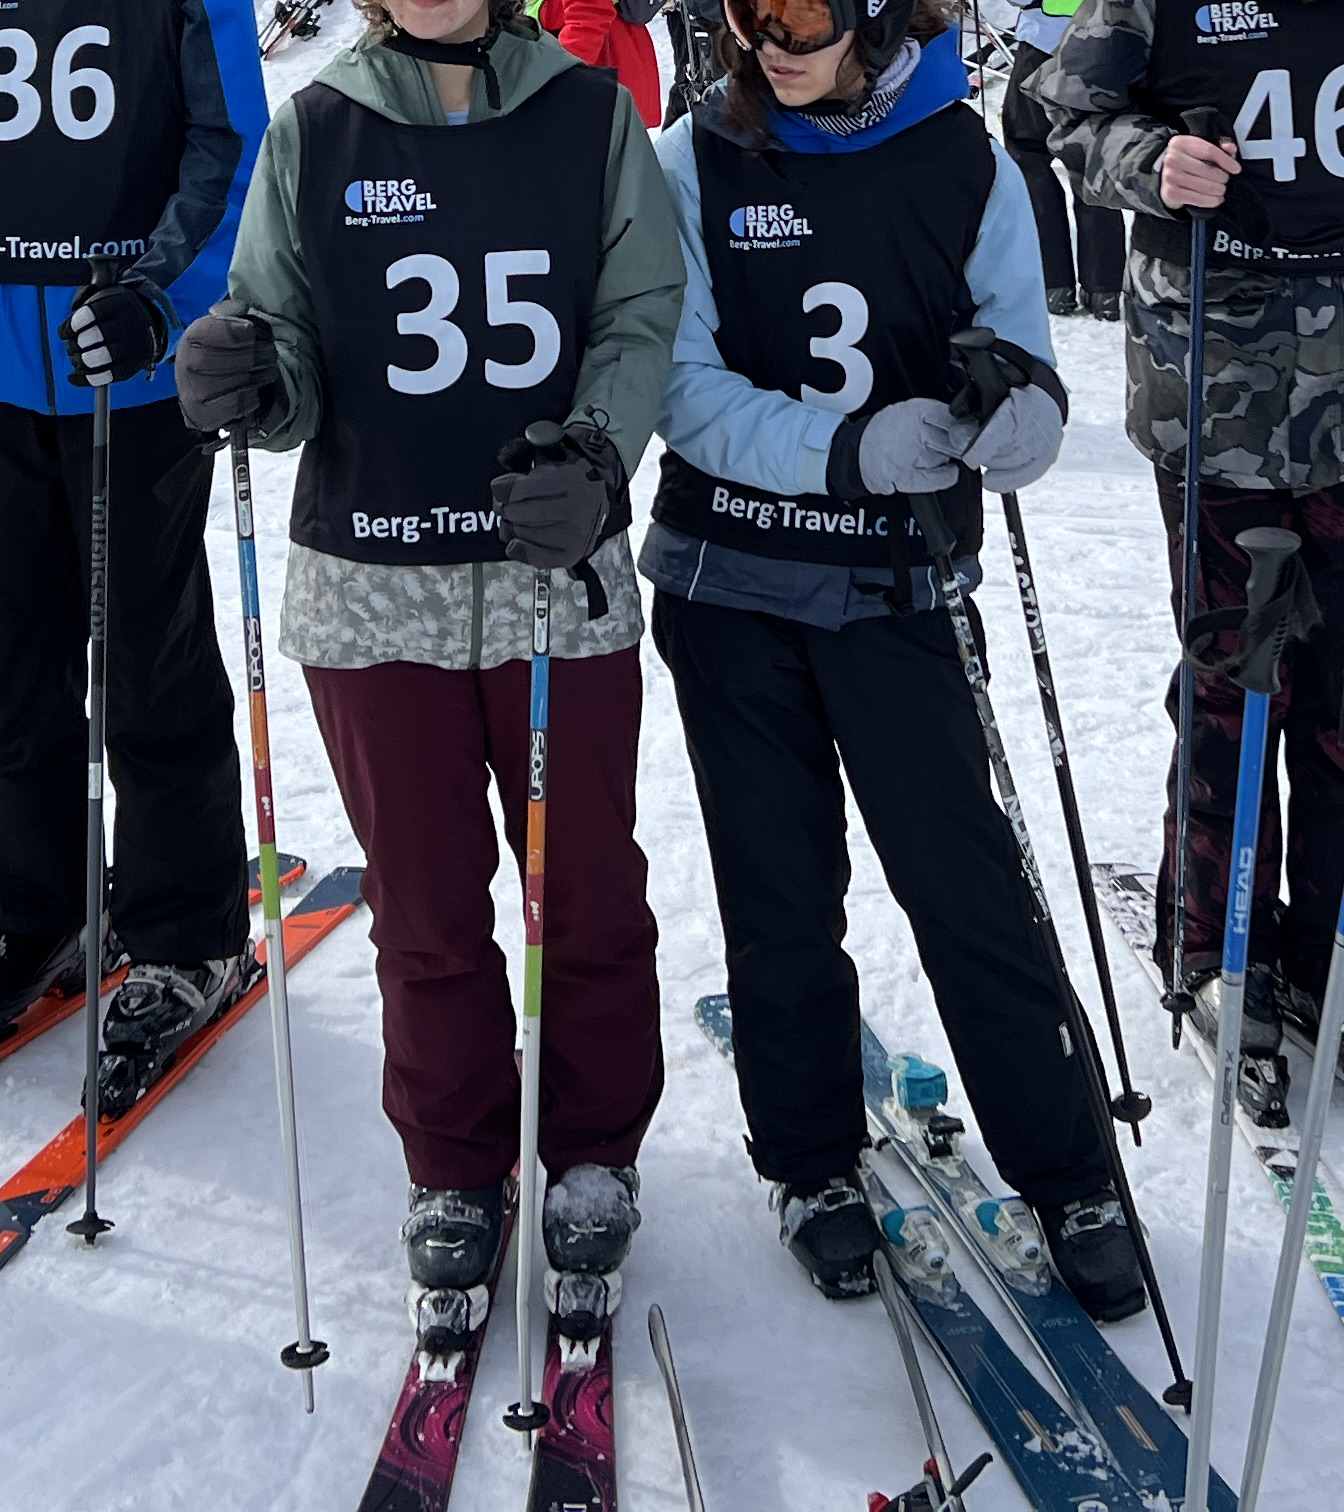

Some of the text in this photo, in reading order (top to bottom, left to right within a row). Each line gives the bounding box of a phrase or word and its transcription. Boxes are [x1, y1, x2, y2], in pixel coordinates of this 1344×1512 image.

[1210, 0, 1259, 18] BERG
[1211, 13, 1279, 33] TRAVEL
[363, 179, 416, 197] BERG
[363, 193, 437, 214] TRAVEL
[746, 204, 794, 222] BERG
[345, 213, 424, 227] Berg-Travel.com
[746, 218, 813, 238] TRAVEL
[729, 238, 801, 251] Berg-Travel.com
[385, 249, 562, 396] 35
[800, 281, 874, 415] 3
[1232, 846, 1254, 936] HEAD
